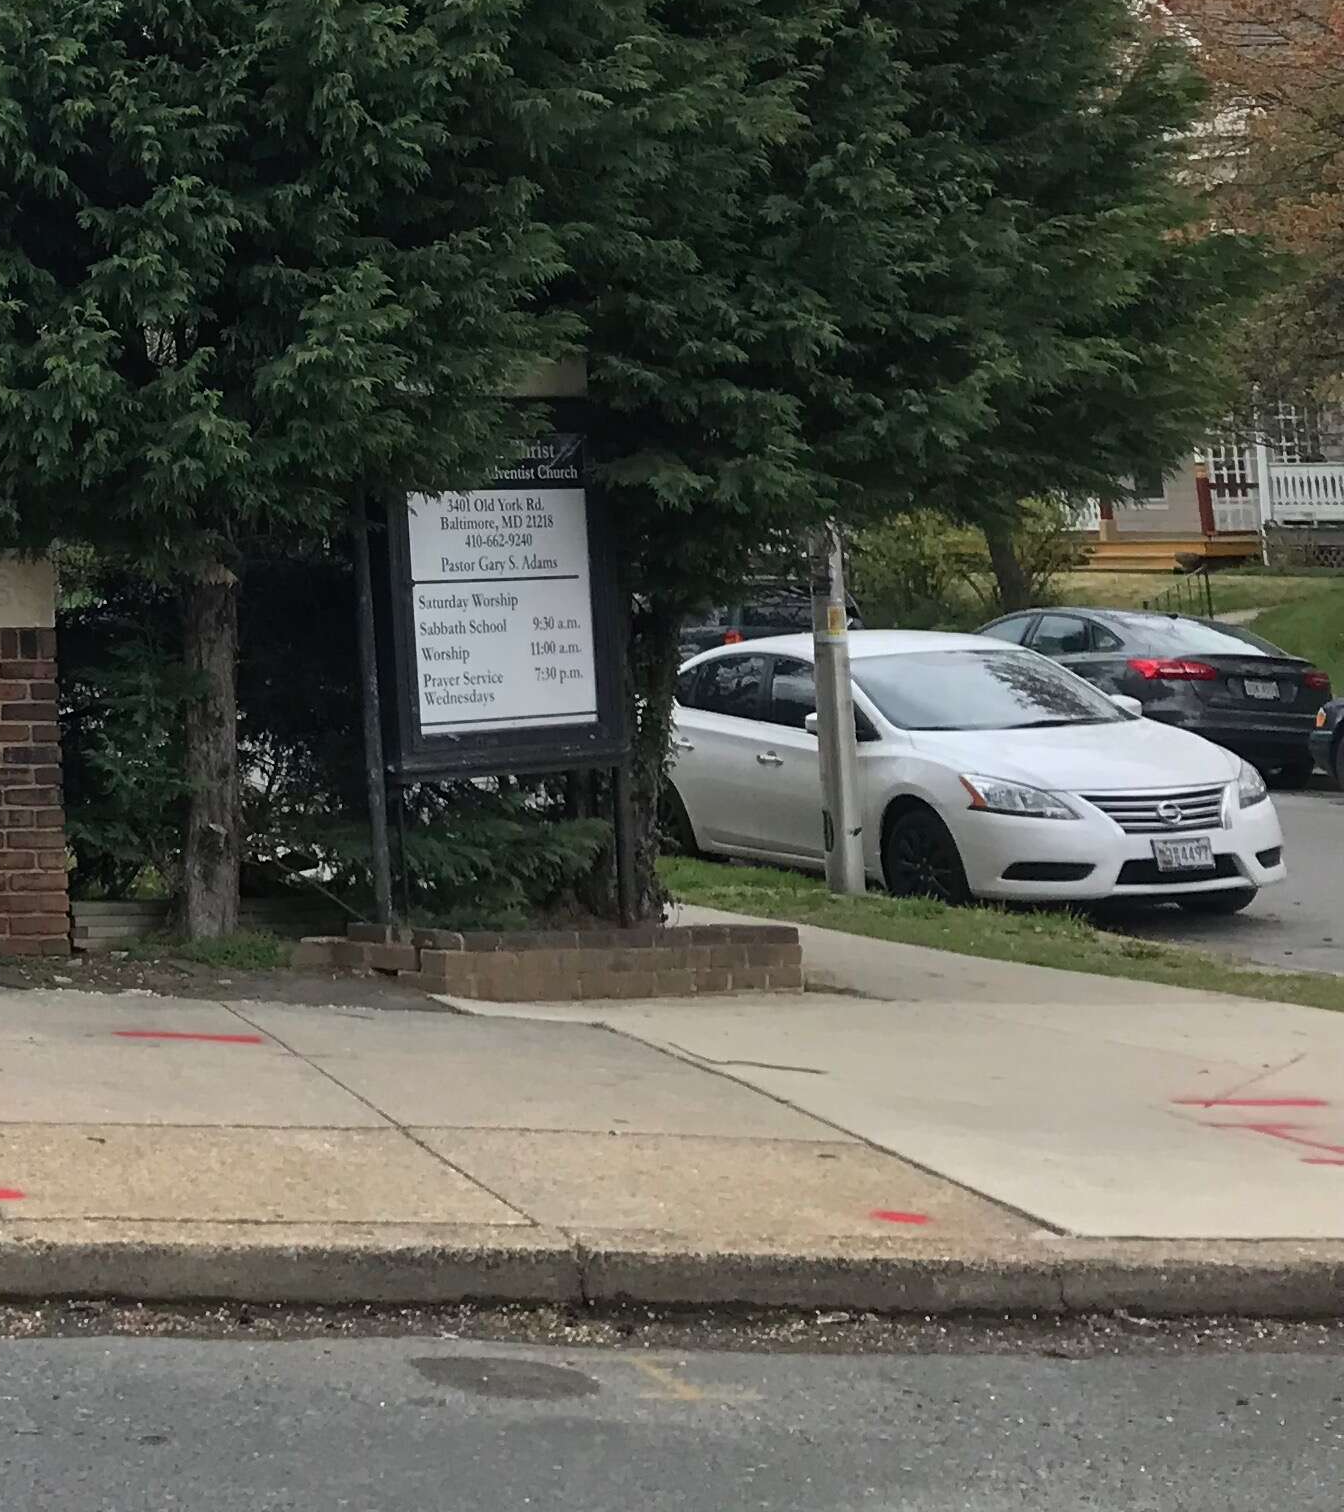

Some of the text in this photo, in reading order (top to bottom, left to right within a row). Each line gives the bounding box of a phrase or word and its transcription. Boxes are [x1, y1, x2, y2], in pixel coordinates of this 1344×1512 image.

[511, 440, 554, 459] hrist
[537, 464, 578, 480] Church
[447, 497, 545, 513] 3401 Old York Rd.
[440, 514, 554, 532] Baltimore, MD 21218
[464, 533, 533, 548] 410-662-9240
[441, 553, 558, 575] Pastor Gary S. Adams
[418, 593, 519, 612] Saturday Worship
[419, 616, 581, 636] Sabbath School 9:30 a.m.
[421, 640, 582, 664] Worship 11:00 a.m.
[423, 666, 584, 692] Prayer Service 7:30 p.m.
[424, 689, 496, 707] Wednesdays
